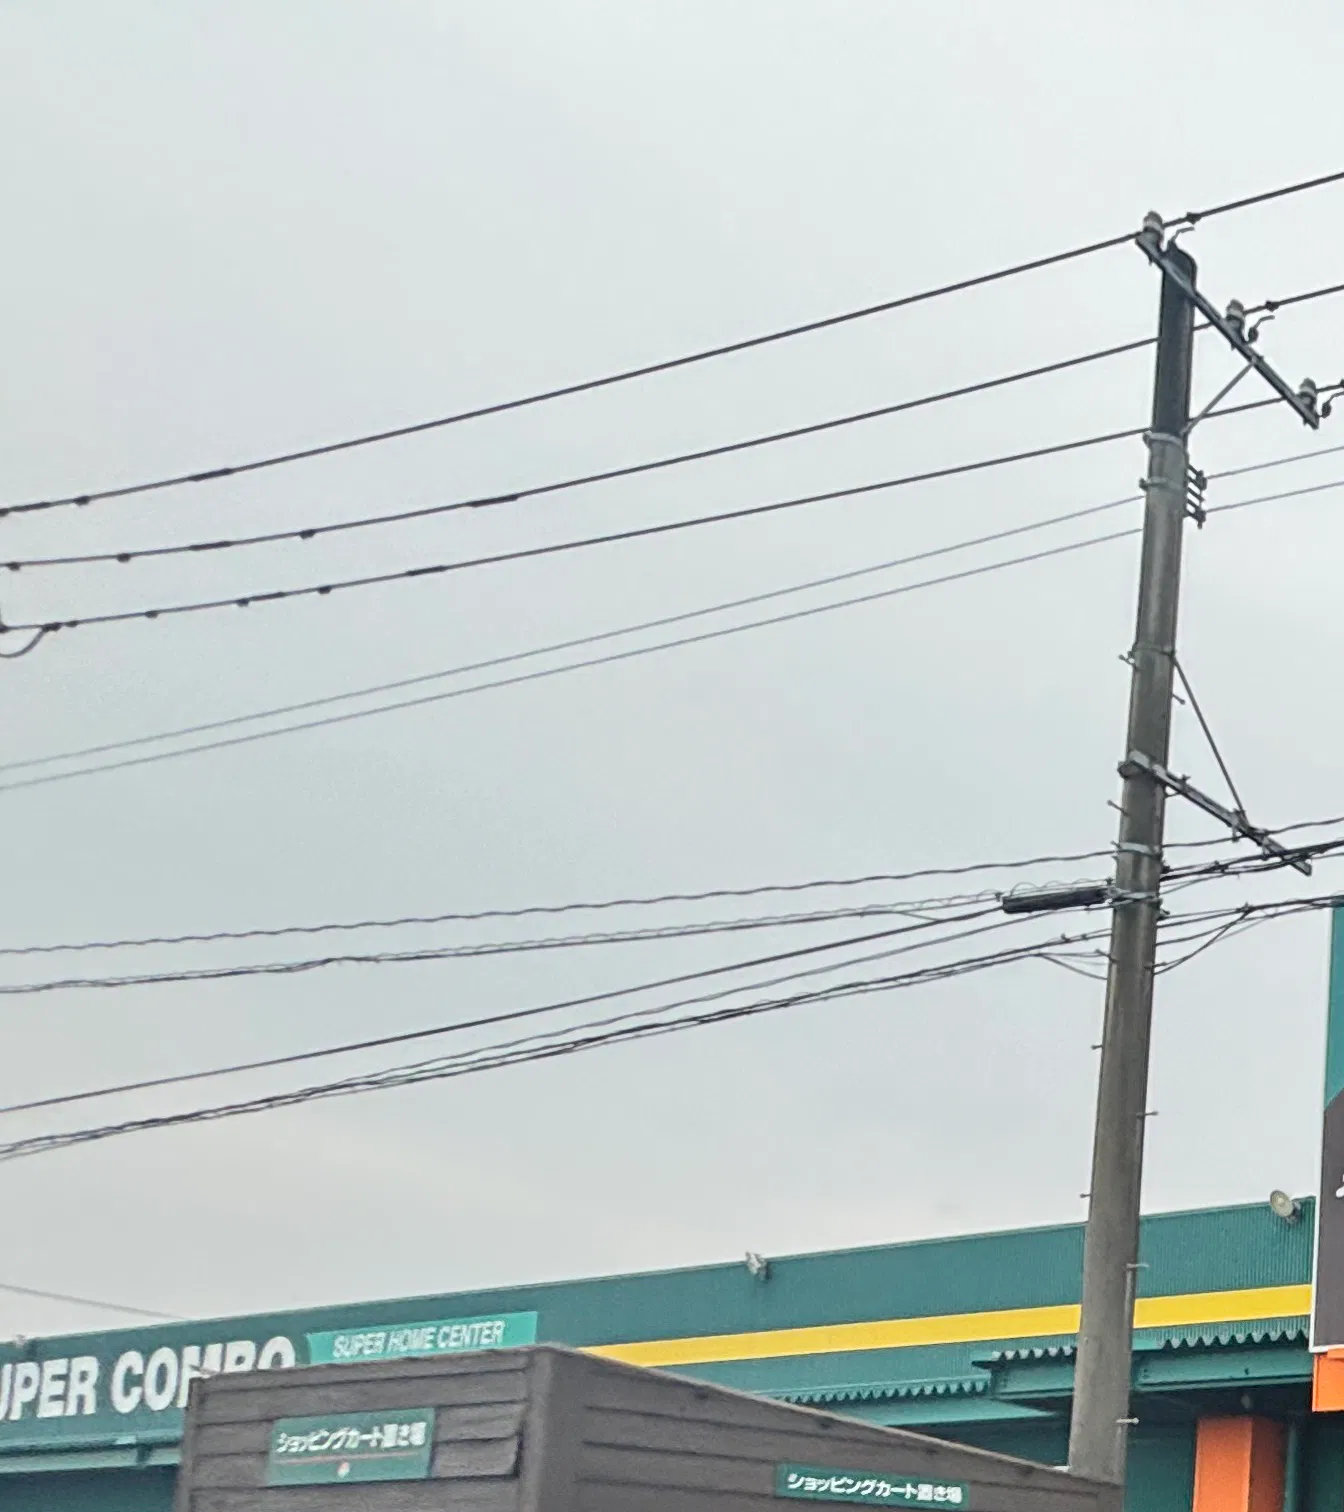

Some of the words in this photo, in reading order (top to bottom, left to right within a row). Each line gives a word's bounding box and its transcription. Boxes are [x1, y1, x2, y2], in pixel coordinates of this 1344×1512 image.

[332, 1331, 385, 1359] SUPER
[387, 1326, 435, 1352] HOME
[437, 1319, 506, 1348] CENTER
[787, 1473, 963, 1504] ショッピングカート置き場
